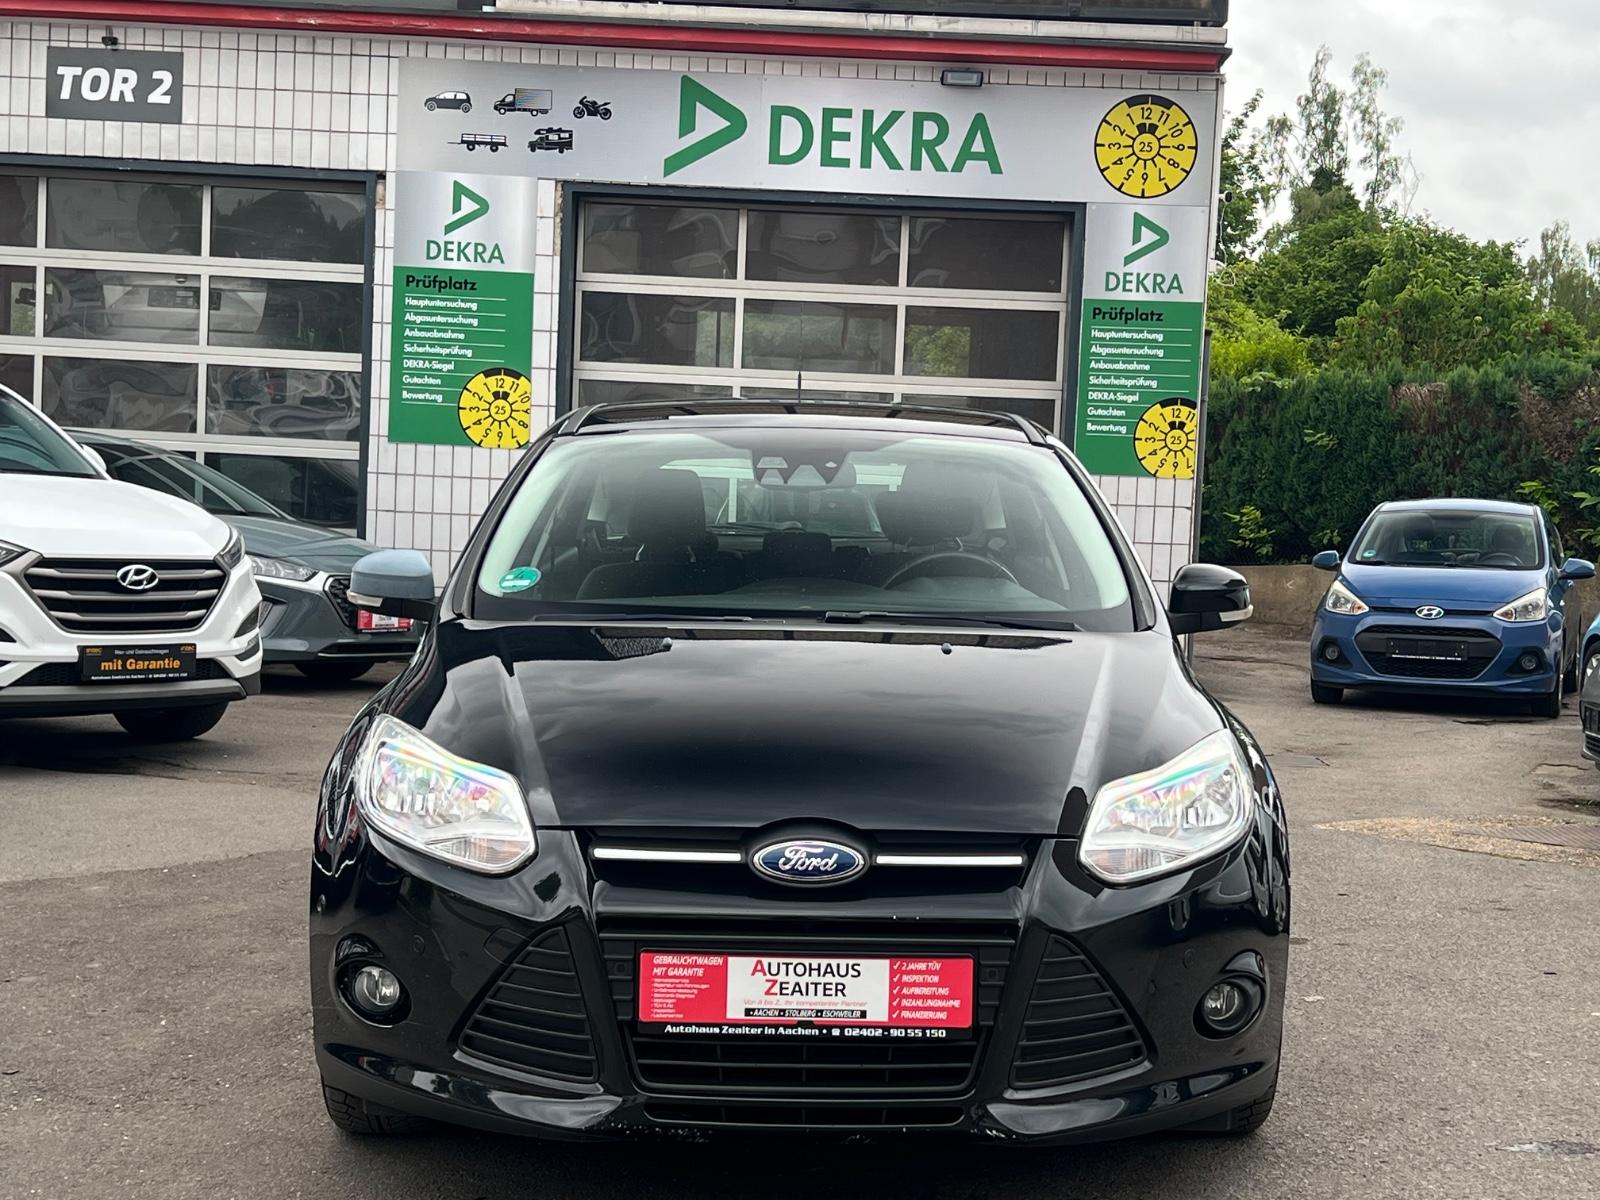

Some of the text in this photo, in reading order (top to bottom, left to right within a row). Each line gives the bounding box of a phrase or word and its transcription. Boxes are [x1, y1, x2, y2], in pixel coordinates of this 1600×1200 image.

[56, 66, 172, 104] TOR 2
[1126, 113, 1135, 125] 1
[1140, 107, 1152, 120] 12
[1158, 111, 1170, 125] 11
[1113, 125, 1126, 136] 2
[1168, 122, 1183, 138] 10
[768, 104, 1004, 174] DEKRA
[1139, 142, 1152, 152] 25
[1112, 157, 1124, 165] 4
[1167, 158, 1179, 169] 8
[1124, 168, 1134, 181] 5
[1142, 172, 1148, 185] 6
[1159, 168, 1166, 182] 7
[426, 240, 505, 264] DEKRA
[406, 275, 477, 293] Prüfplatz
[1105, 272, 1183, 294] DEKRA
[405, 297, 477, 311] Hauptuntersuchung
[404, 313, 478, 326] Abgasuntersuchung
[1092, 307, 1163, 324] Prüfplatz
[404, 328, 465, 339] Anbauabnahme
[1091, 329, 1163, 342] Hauptuntersuchung
[404, 344, 472, 357] Sicherheitsprüfung
[1090, 345, 1164, 357] Abgasuntersuchung
[403, 360, 454, 371] DEKRA-Siegel
[1090, 361, 1150, 370] Anbauabnahme
[403, 375, 441, 385] Gutachten
[495, 378, 505, 388] 12
[1089, 376, 1157, 388] Sicherheitsprüfung
[483, 382, 491, 392] 1
[510, 381, 519, 392] 11
[402, 391, 442, 402] Bewertung
[472, 392, 483, 401] 2
[1088, 392, 1139, 403] DEKRA-Siegel
[494, 406, 506, 415] 25
[1088, 407, 1125, 416] Gutachten
[1172, 408, 1181, 418] 12
[518, 420, 528, 428] 8
[1087, 423, 1126, 433] Bewertung
[1149, 422, 1160, 432] 2
[482, 428, 491, 438] 5
[497, 431, 503, 441] 6
[1170, 436, 1182, 445] 25
[1158, 458, 1167, 468] 5
[1173, 461, 1178, 472] 6
[101, 658, 180, 670] mit Garantie
[779, 846, 838, 871] Ford
[653, 956, 724, 966] GEBRAUCHTWAGEN
[928, 961, 942, 970] TÜV
[652, 967, 704, 977] MIT GARANTIE
[751, 960, 861, 978] AUTOHAUS
[902, 975, 940, 983] INSPEKTION
[764, 979, 846, 997] ZEAITER
[901, 987, 949, 995] AUFBEREITUNG
[901, 999, 961, 1008] INZAHLUNGNAHME
[900, 1011, 947, 1019] FINANZIERUNG
[664, 1025, 720, 1034] Autohaus
[722, 1026, 763, 1034] Zeaiter
[777, 1027, 819, 1036] Aachen
[844, 1028, 882, 1036] 02402
[890, 1029, 905, 1037] 90
[907, 1029, 922, 1037] 55
[926, 1029, 946, 1038] 150
